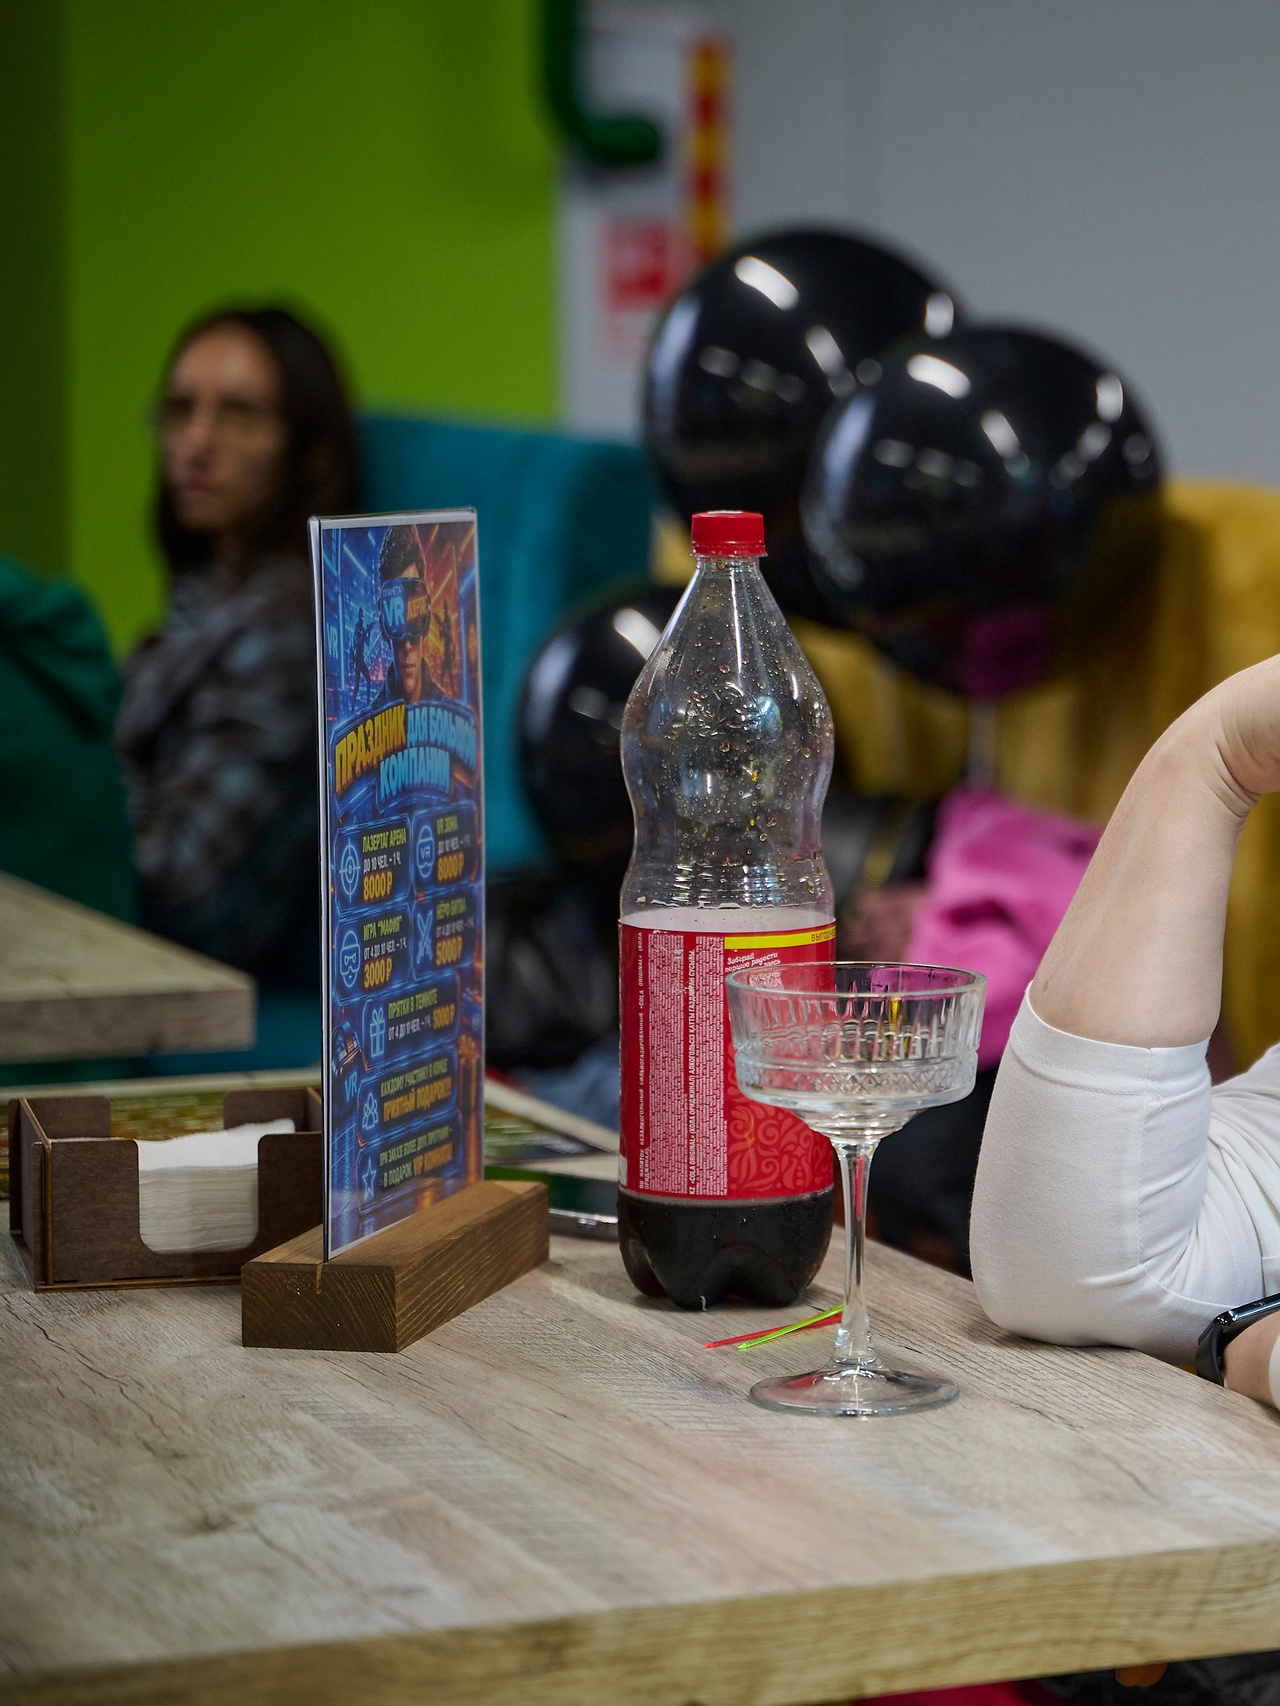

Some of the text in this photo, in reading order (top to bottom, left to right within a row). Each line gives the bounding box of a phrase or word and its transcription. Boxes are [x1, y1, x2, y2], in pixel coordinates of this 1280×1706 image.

[384, 597, 405, 626] VR
[326, 622, 338, 659] VR
[335, 704, 406, 794] ПРАЗДНИК
[407, 707, 428, 748] ДЛЯ
[380, 746, 450, 800] КОМПАНИИ
[362, 828, 407, 853] ЛАЗЕРТАГ АРЕНА
[420, 846, 431, 859] VR
[364, 858, 370, 874] ДО
[371, 856, 376, 870] 10
[378, 854, 388, 869] ЧЕЛ.
[438, 854, 458, 881] 8000
[364, 872, 386, 900] 8000
[364, 922, 377, 941] ИГРА
[364, 947, 370, 960] ОТ
[374, 944, 380, 959] ДО
[436, 937, 457, 965] 5000
[727, 952, 755, 965] Забирай
[751, 952, 778, 966] радости
[364, 959, 385, 988] 3000
[688, 978, 696, 1012] ГАЗДААН
[388, 998, 410, 1020] ПРЯТКИ
[345, 1071, 357, 1102] VR
[384, 1088, 416, 1122] ПРИЯТНЫЙ
[388, 1161, 412, 1186] ПОДАРОК
[689, 1187, 696, 1195] KZ
